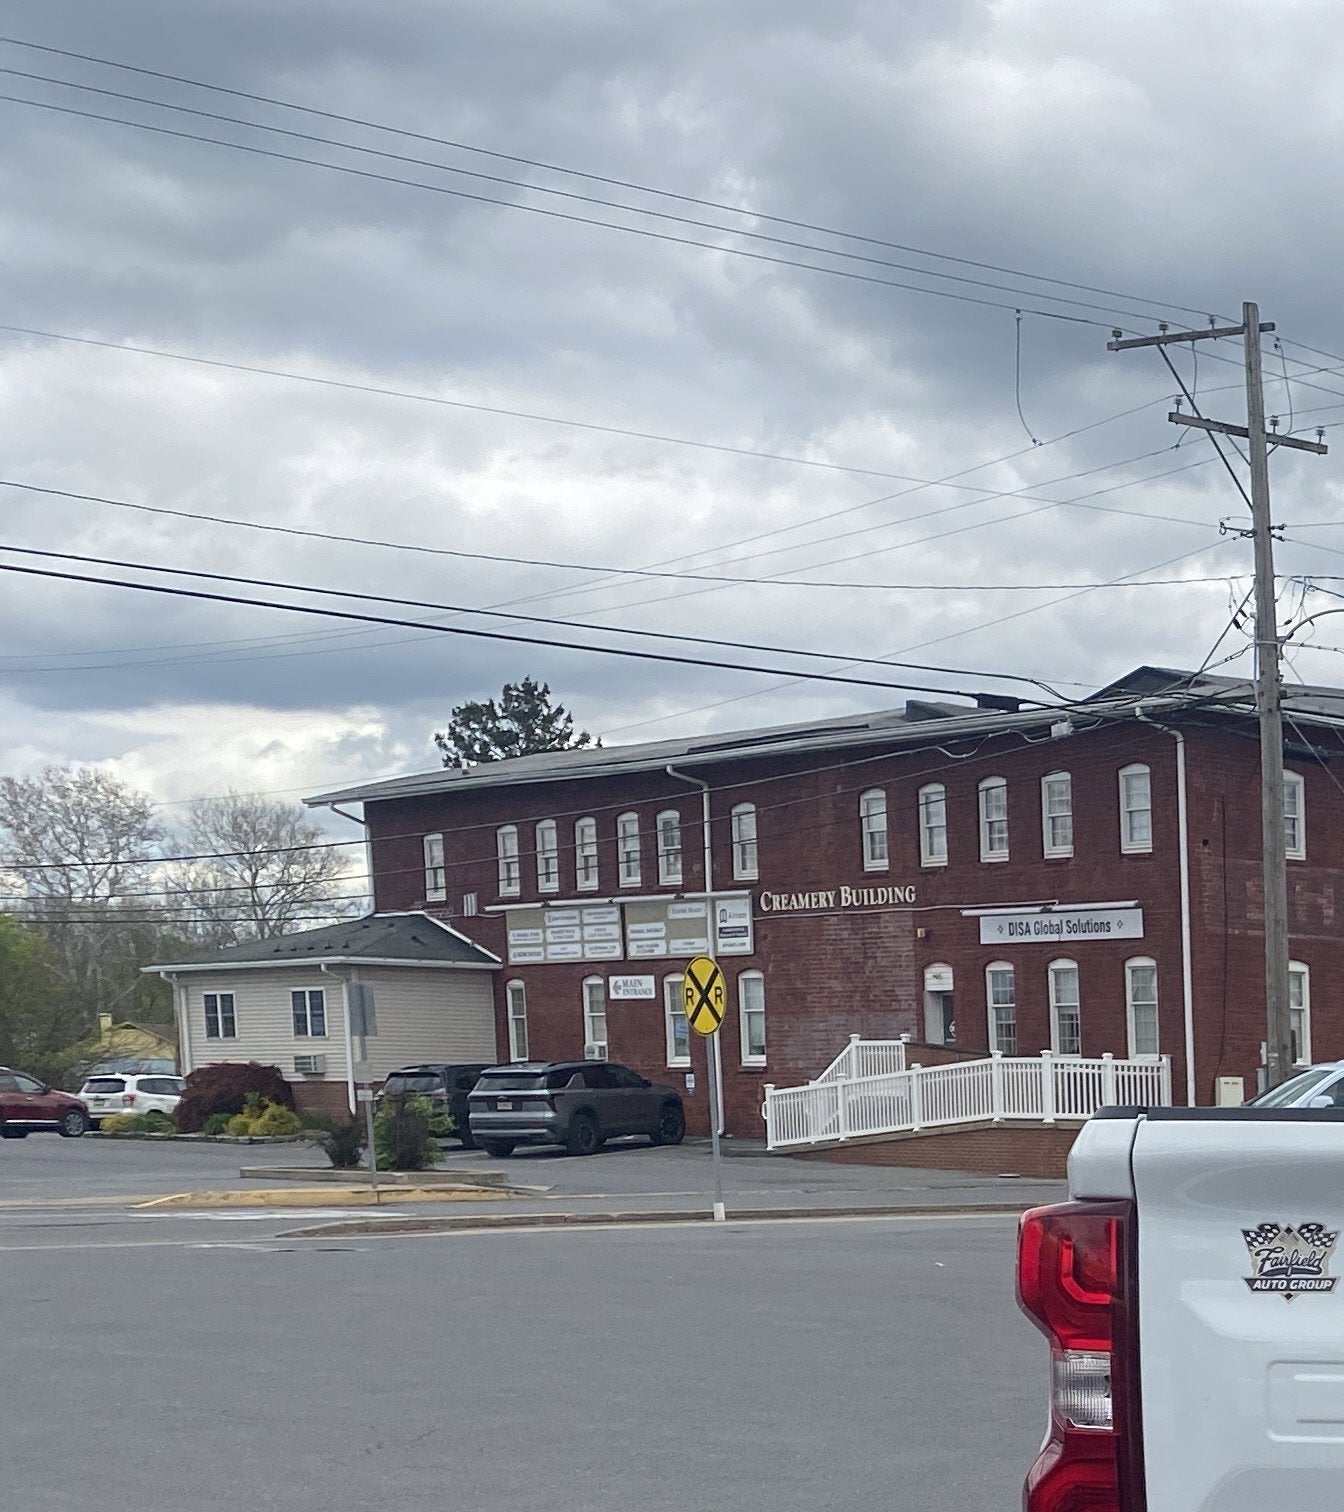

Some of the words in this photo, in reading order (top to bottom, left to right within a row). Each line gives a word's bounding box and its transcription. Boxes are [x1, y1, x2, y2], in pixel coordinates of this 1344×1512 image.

[760, 891, 836, 912] CREAMERY
[839, 885, 917, 907] BUILDING
[1008, 921, 1032, 936] DISA
[1033, 919, 1063, 935] Global
[1066, 918, 1111, 934] Solutions
[622, 979, 643, 987] MAIN
[622, 987, 653, 996] ENTRANCE
[1254, 1246, 1328, 1277] Fairfield
[1252, 1279, 1287, 1290] AUTO
[1289, 1279, 1333, 1290] GROUP
